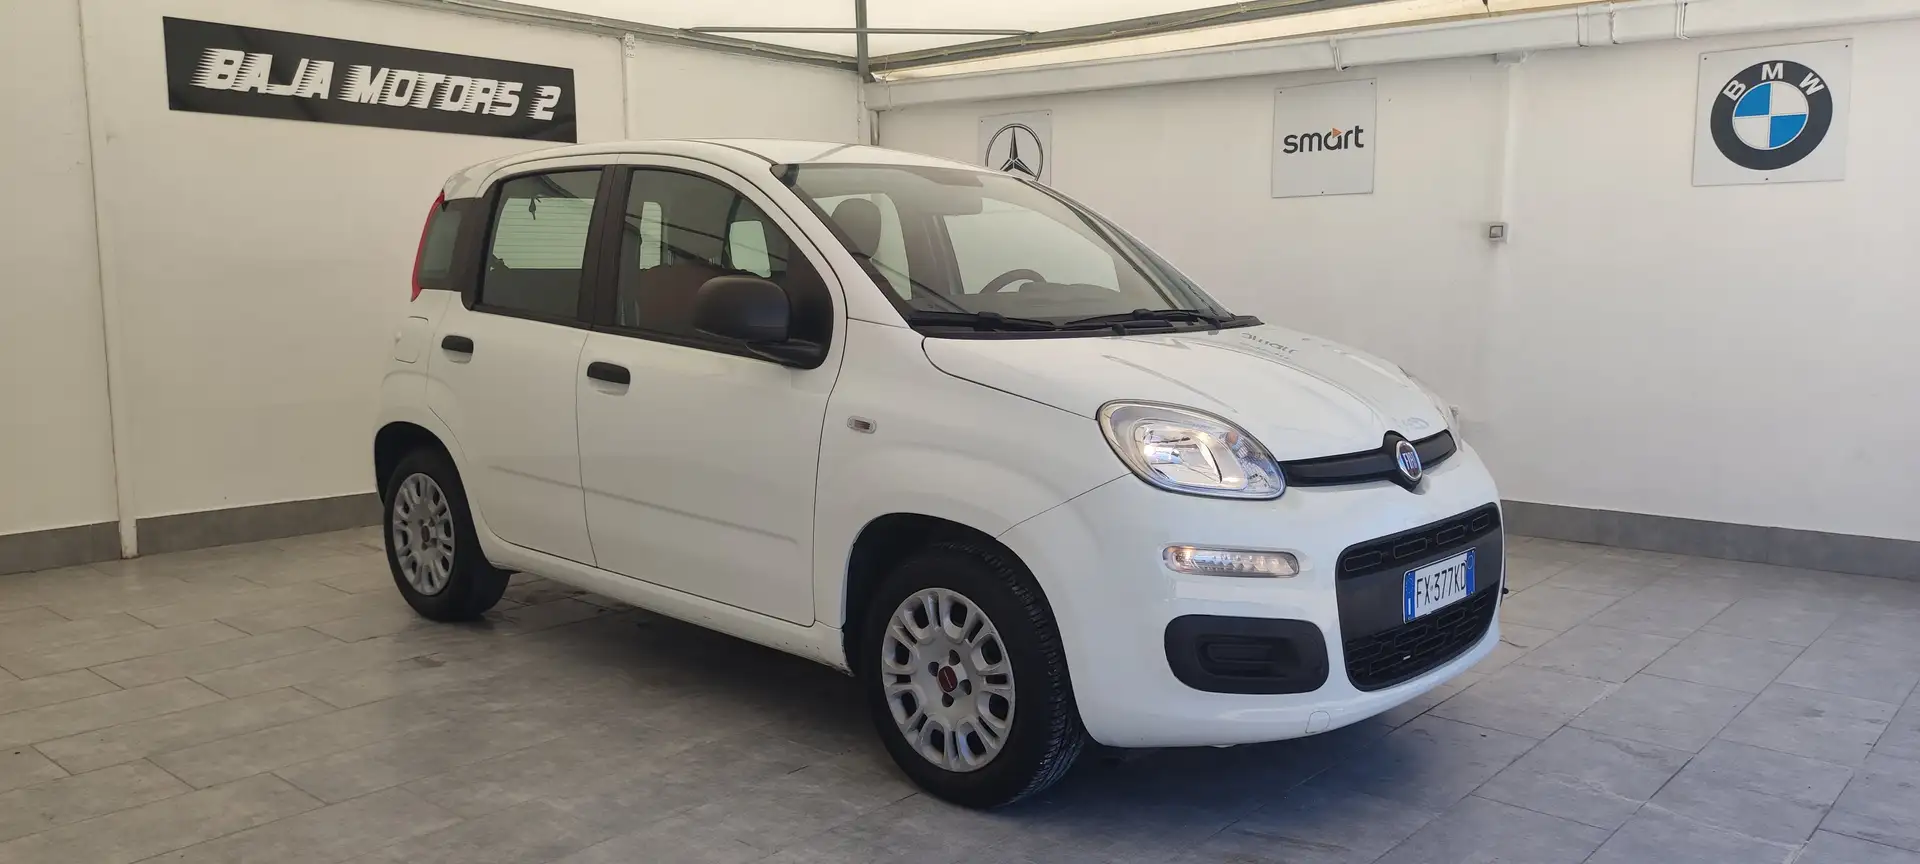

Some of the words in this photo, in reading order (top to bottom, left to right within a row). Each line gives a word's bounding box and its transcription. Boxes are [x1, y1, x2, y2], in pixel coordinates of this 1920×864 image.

[189, 48, 334, 99] BAJA
[337, 64, 522, 116] MOTORS
[526, 85, 562, 121] 2
[1722, 62, 1825, 101] BMW
[1282, 125, 1365, 154] smart
